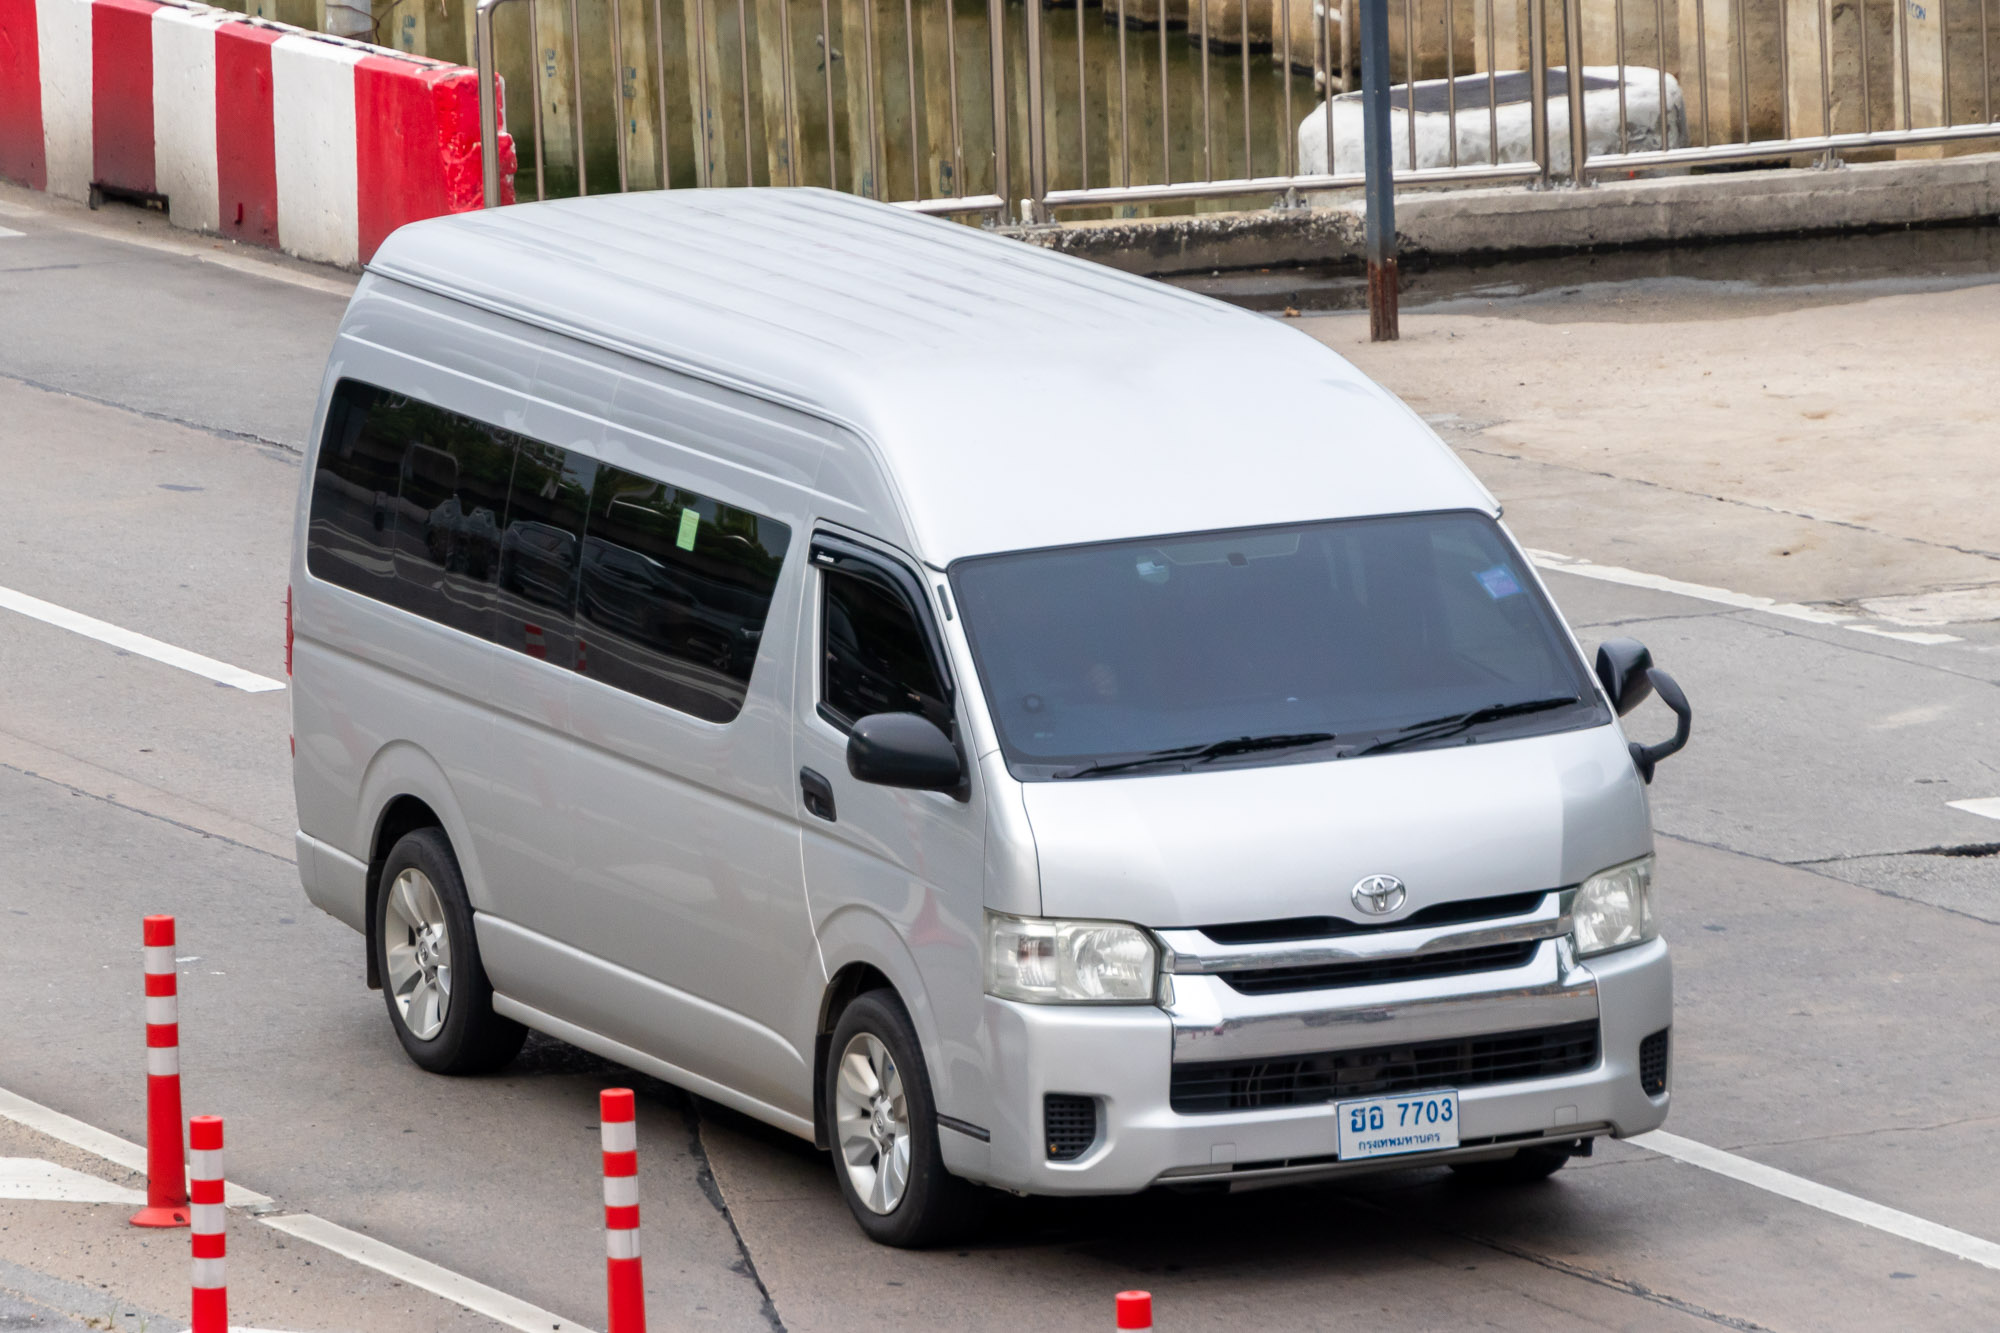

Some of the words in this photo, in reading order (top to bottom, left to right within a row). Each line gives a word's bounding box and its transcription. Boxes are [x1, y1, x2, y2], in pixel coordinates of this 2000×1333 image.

[1397, 1098, 1453, 1127] 7703
[1358, 1132, 1440, 1154] กรุงเทพมหานคร
